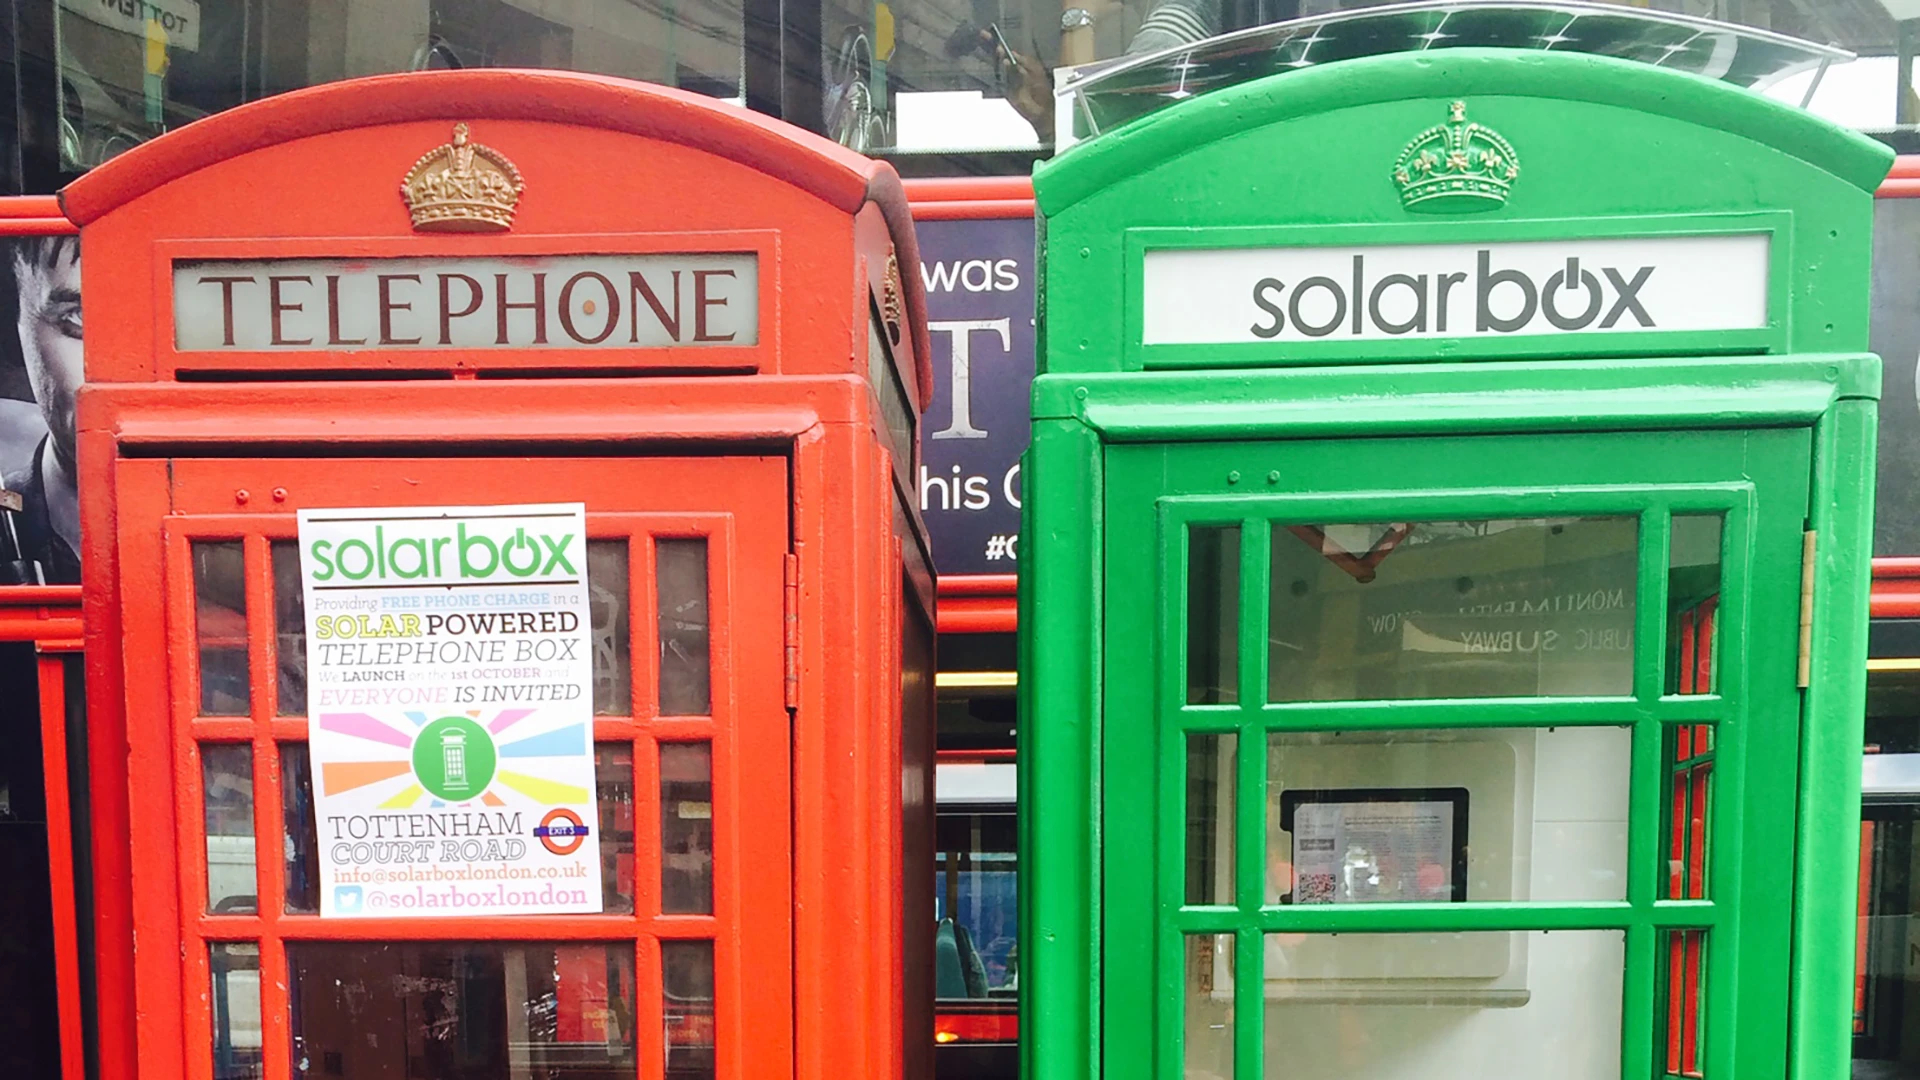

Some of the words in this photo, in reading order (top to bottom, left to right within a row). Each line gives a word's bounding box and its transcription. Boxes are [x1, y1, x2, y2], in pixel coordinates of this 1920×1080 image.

[920, 259, 1020, 293] was
[197, 270, 737, 346] TELEPHONE
[1250, 249, 1657, 339] solarbox
[311, 522, 578, 581] solarbox
[314, 594, 378, 612] Providing
[381, 595, 421, 609] FREE
[424, 593, 481, 609] PHONE
[484, 592, 551, 607] CHARGE
[553, 593, 567, 605] in
[569, 594, 580, 605] a
[315, 613, 423, 640] SOLAR
[425, 611, 579, 635] POWERED
[318, 640, 507, 666] TELEPHONE
[512, 638, 581, 662] BOX
[318, 671, 339, 683] We
[342, 670, 406, 682] LAUNCH
[408, 672, 425, 681] on
[427, 668, 447, 681] the
[451, 669, 468, 680] 1st
[471, 666, 541, 680] OCTOBER
[544, 664, 570, 679] and
[319, 686, 448, 706] EVERYONE
[453, 685, 476, 703] IS
[481, 683, 582, 702] INVITED
[327, 811, 525, 840] TOTTENHAM
[331, 840, 435, 865] COURT
[439, 838, 527, 863] ROAD
[333, 861, 588, 885] info@solarboxlondon.co.uk
[366, 883, 588, 912] @solarboxlondon
